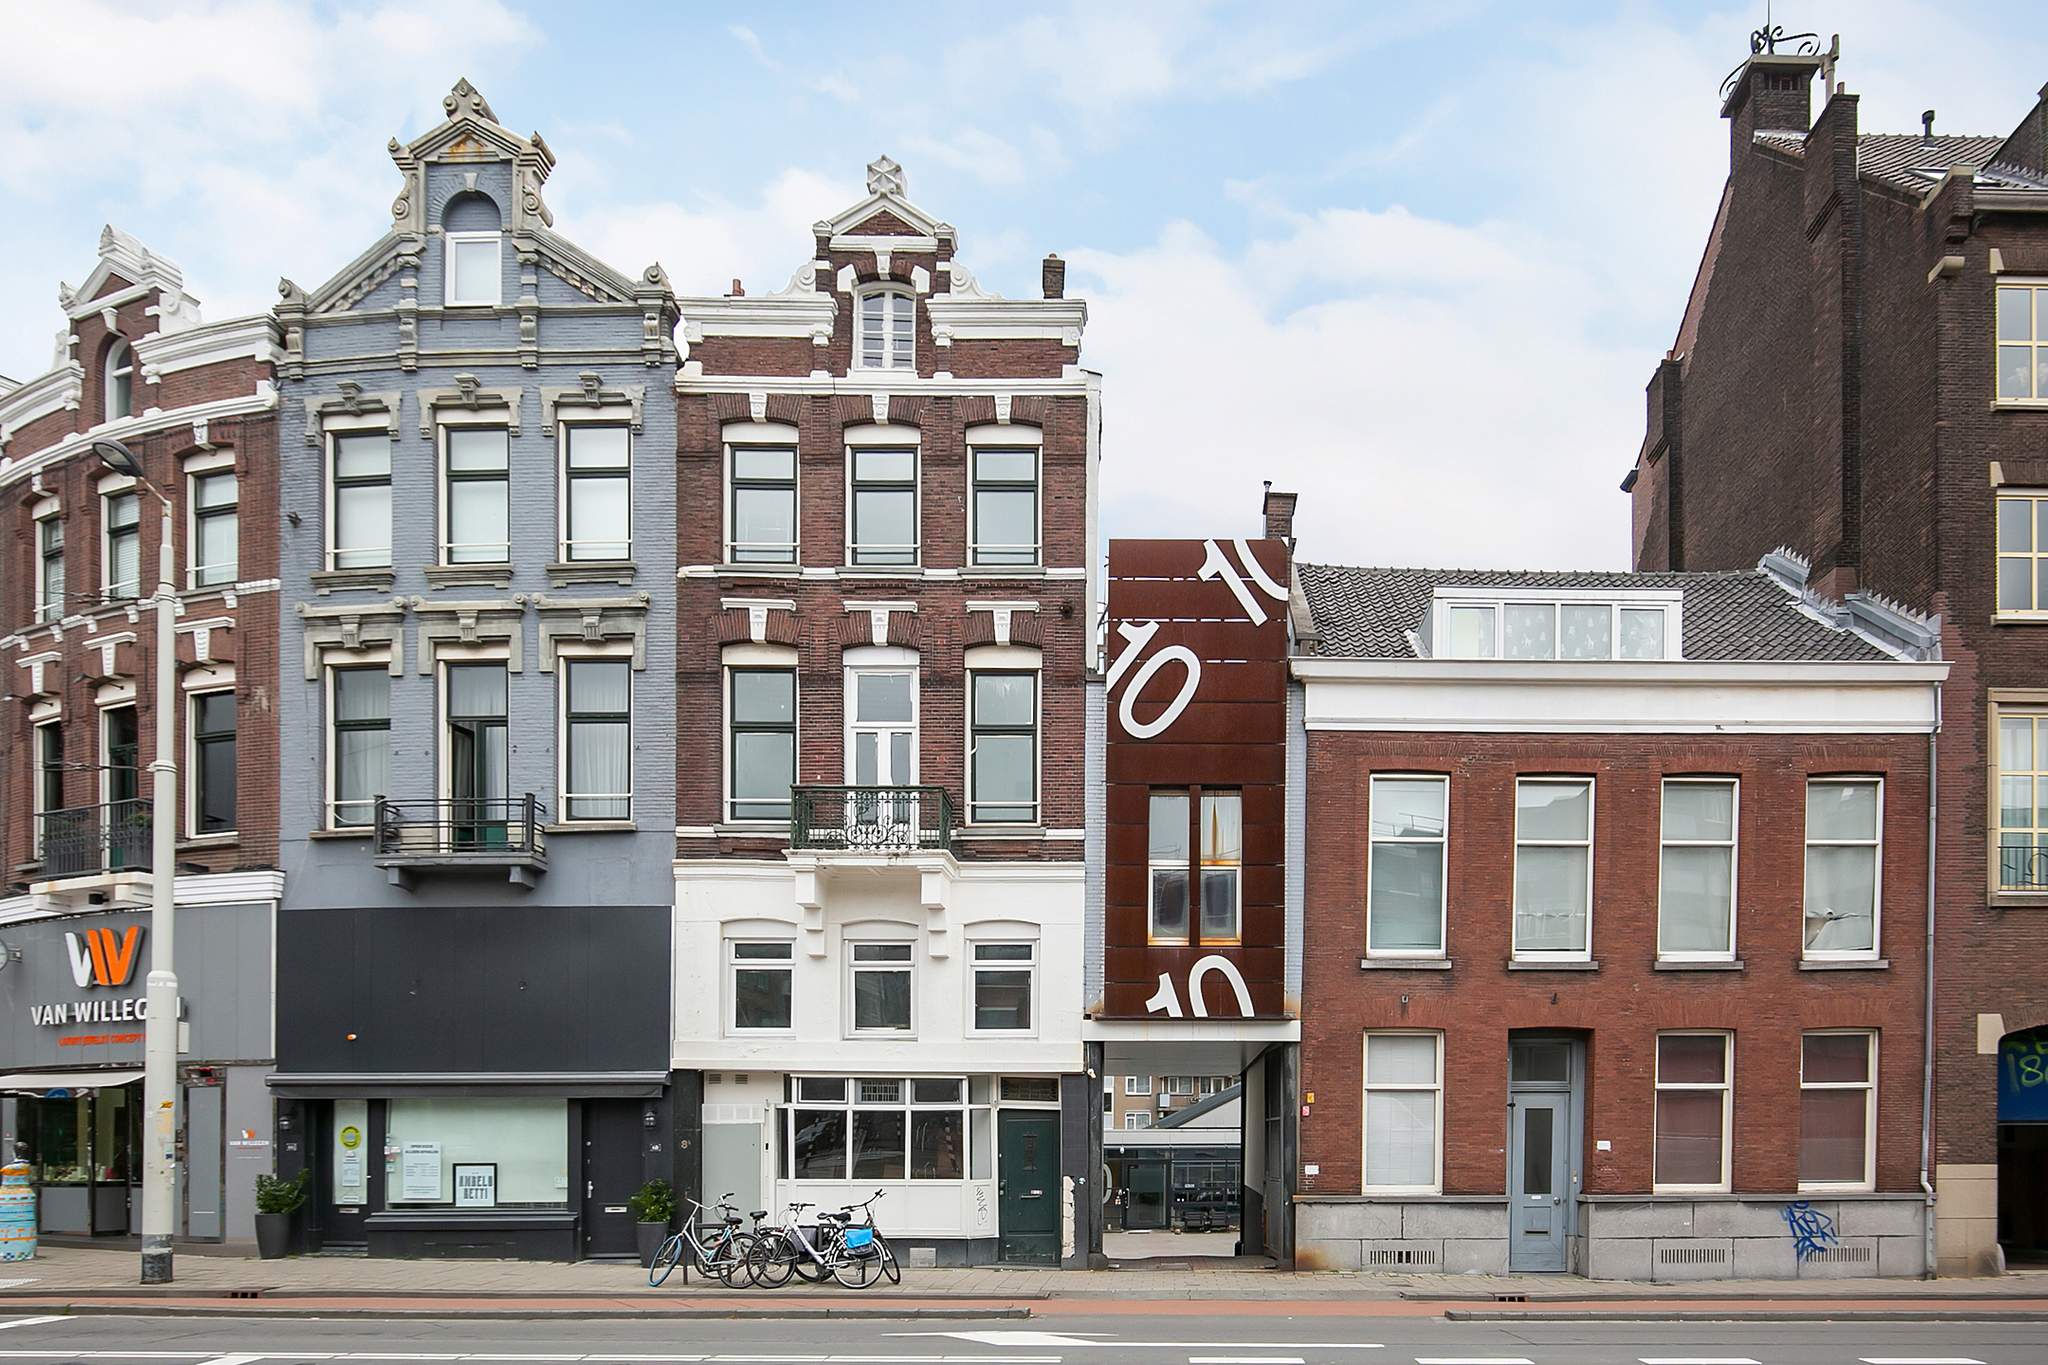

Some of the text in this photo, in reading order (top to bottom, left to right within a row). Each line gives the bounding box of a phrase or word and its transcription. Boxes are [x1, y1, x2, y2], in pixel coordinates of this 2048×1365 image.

[1106, 620, 1202, 739] 10
[30, 996, 181, 1026] VAN WILLEG
